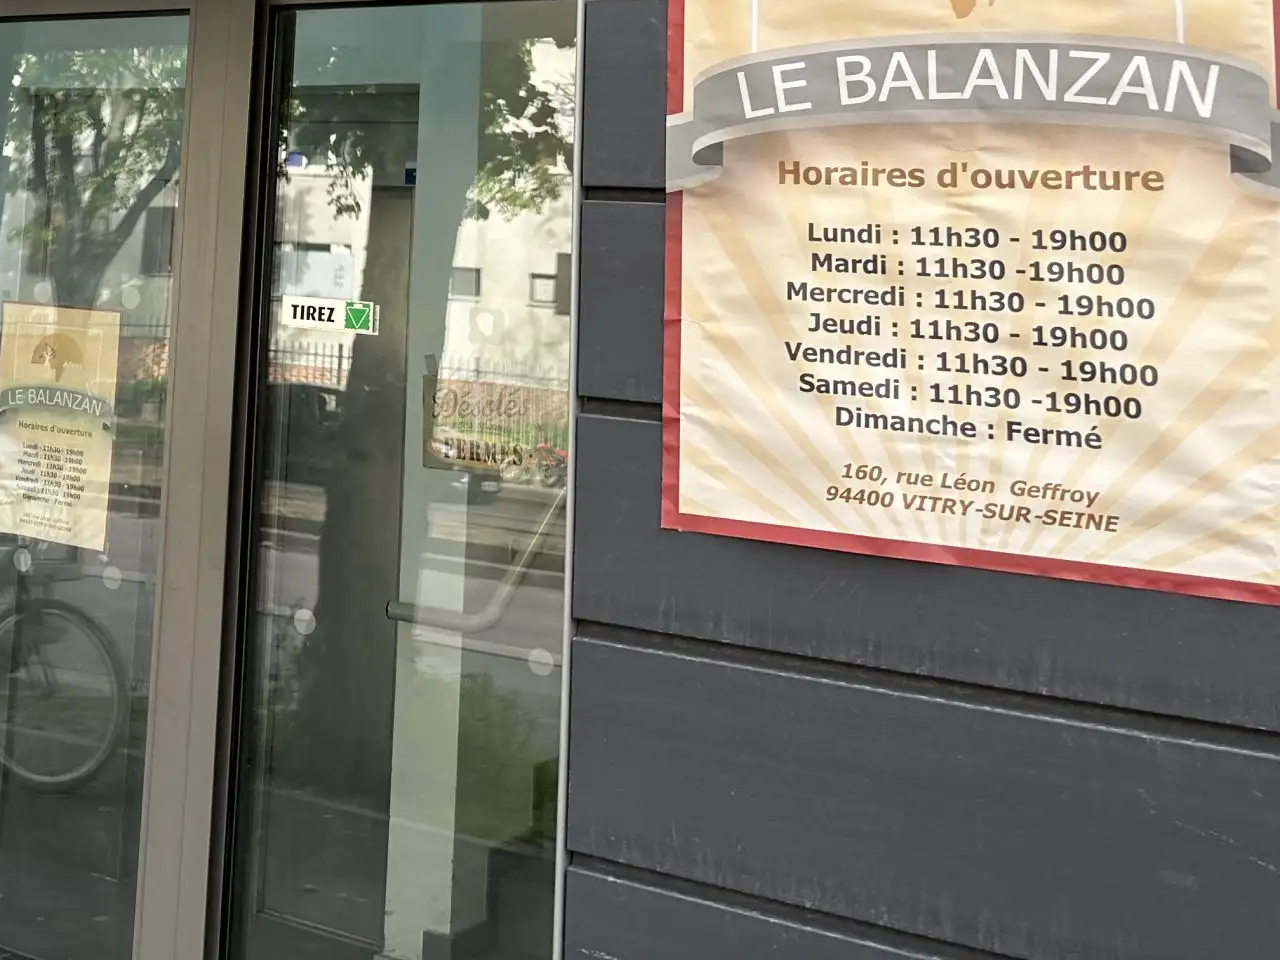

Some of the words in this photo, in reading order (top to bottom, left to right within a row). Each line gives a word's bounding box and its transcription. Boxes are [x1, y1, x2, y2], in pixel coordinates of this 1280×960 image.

[736, 61, 813, 119] LE
[836, 48, 1219, 118] BALANZAN
[777, 160, 926, 188] Horaires
[937, 161, 1165, 192] d'ouverture
[807, 222, 883, 245] Lundi
[910, 226, 1000, 249] 11h30
[1031, 229, 1127, 253] 19h00
[811, 253, 887, 276] Mardi
[916, 257, 1005, 281] 11h30
[291, 304, 336, 323] TIREZ
[786, 282, 905, 308] Mercredi
[934, 288, 1025, 313] 11h30
[1057, 295, 1155, 320] 19h00
[807, 312, 881, 337] Jeudi
[909, 317, 999, 343] 11h30
[1031, 325, 1128, 351] 19h00
[784, 342, 907, 370] Vendredi
[935, 351, 1027, 378] 11h30
[1060, 361, 1159, 387] 19h00
[9, 389, 24, 405] LE
[28, 388, 102, 416] BALANZAN
[799, 374, 900, 401] Samedi
[929, 383, 1020, 410] 11h30
[19, 420, 48, 431] Horaires
[50, 424, 93, 438] d'ouverture
[835, 407, 976, 439] Dimanche
[1006, 420, 1102, 450] Fermé
[841, 464, 889, 486] 160,
[896, 472, 933, 488] rue
[940, 471, 996, 494] Léon
[1010, 480, 1099, 508] Geffroy
[825, 486, 894, 509] 94400
[902, 494, 1120, 533] VITRY-SUR-SEINE
